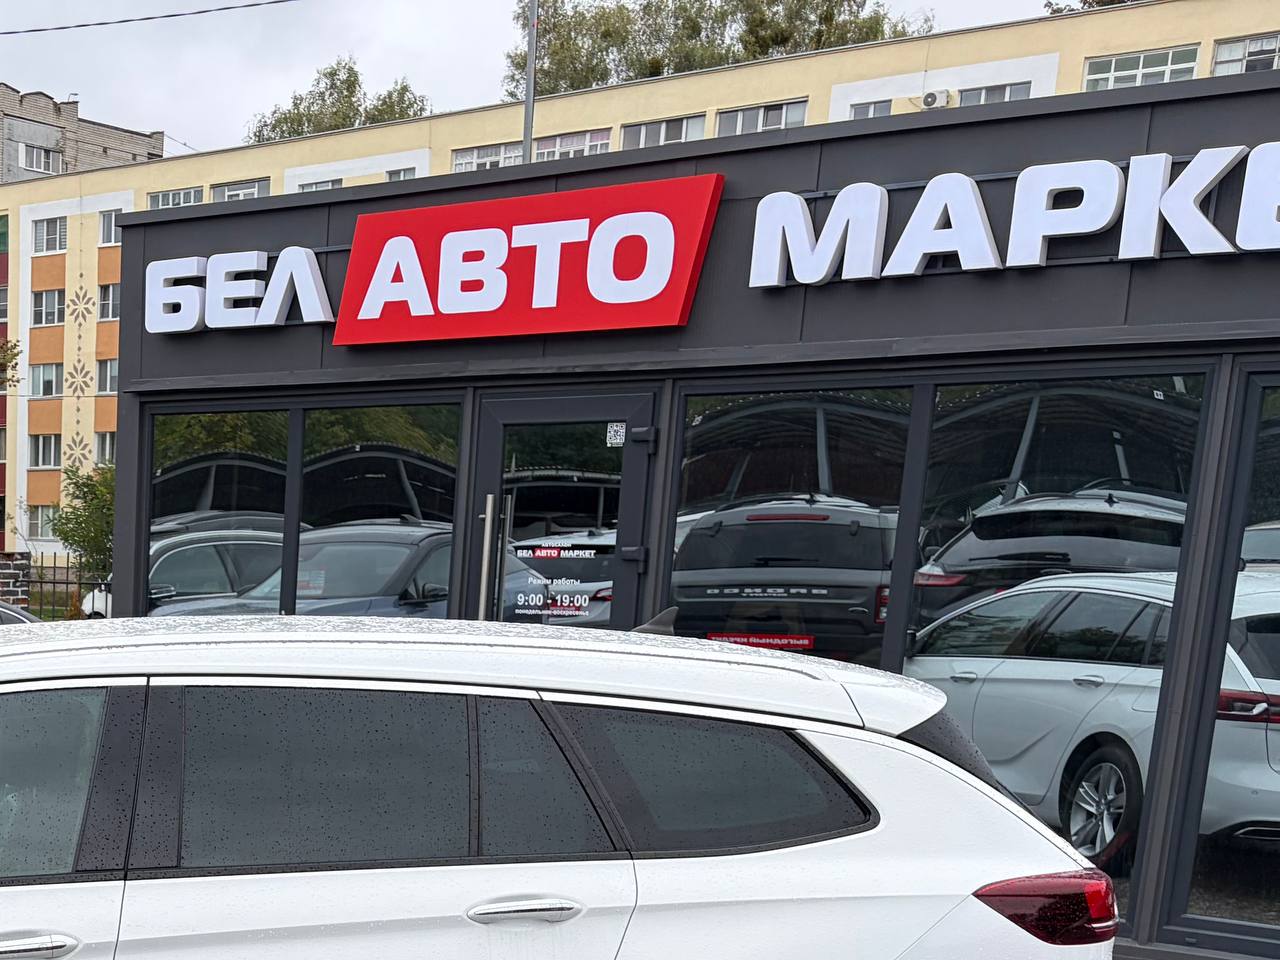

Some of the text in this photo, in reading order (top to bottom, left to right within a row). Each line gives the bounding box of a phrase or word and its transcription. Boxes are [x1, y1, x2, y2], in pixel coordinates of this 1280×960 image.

[145, 246, 336, 334] БЕЛ
[357, 211, 676, 320] АВТО
[517, 549, 596, 558] БЕЛ АВТО МАРКЕТ
[528, 577, 581, 586] Режим работы
[517, 593, 544, 606] 9:00
[555, 594, 589, 607] 19:00
